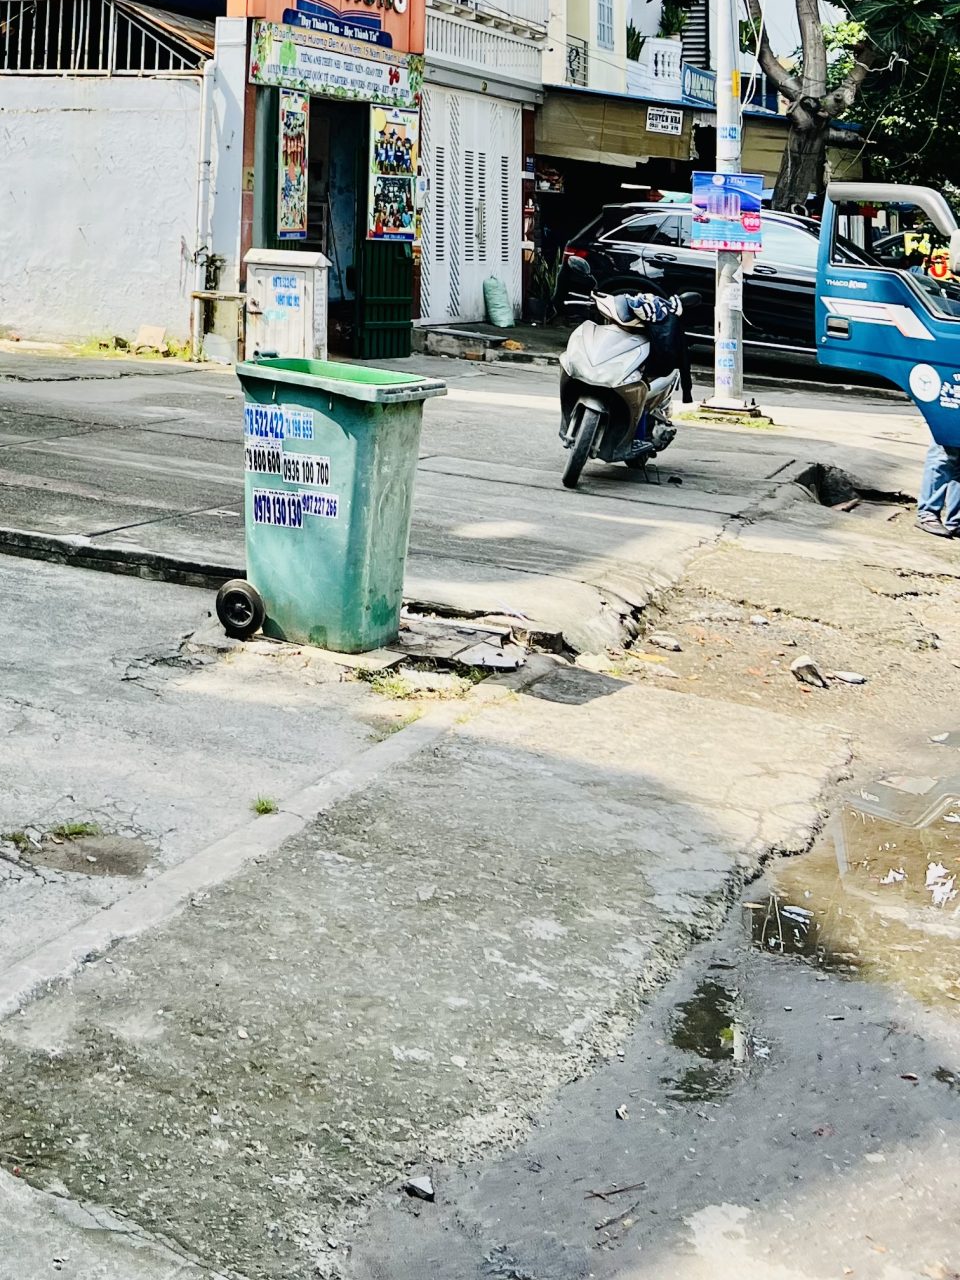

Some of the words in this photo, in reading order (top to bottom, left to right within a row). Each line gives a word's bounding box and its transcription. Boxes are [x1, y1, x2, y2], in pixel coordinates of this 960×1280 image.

[283, 458, 300, 481] 0936
[302, 461, 314, 483] 100
[316, 462, 329, 485] 700
